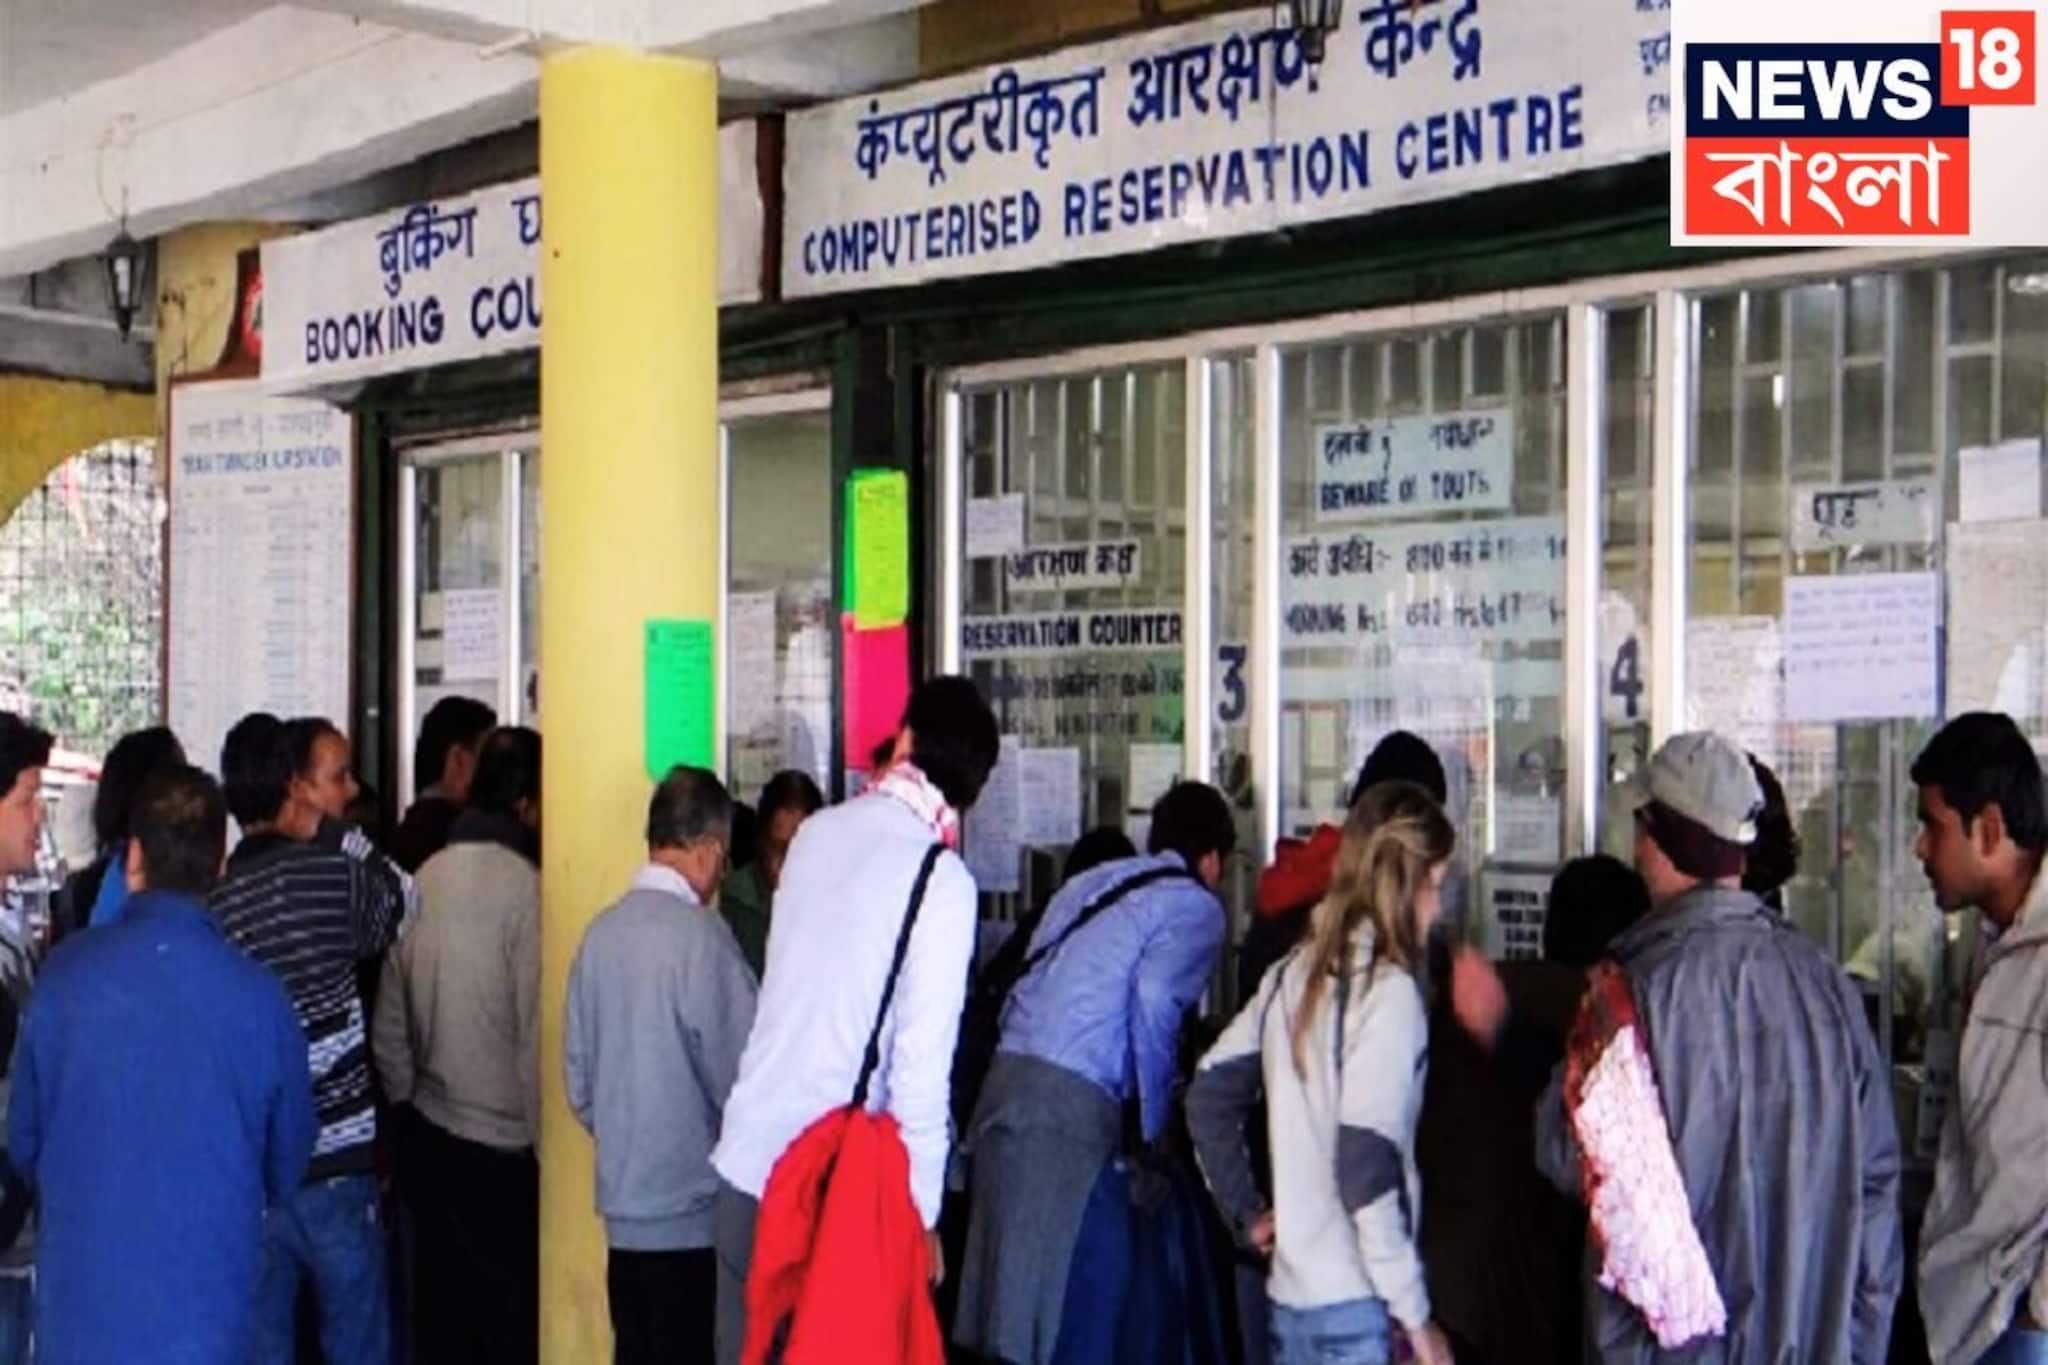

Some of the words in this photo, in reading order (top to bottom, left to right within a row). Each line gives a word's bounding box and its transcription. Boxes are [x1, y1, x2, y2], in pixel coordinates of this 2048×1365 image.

[804, 188, 1041, 275] COMPUTERISED
[1063, 130, 1370, 239] RESERVATION
[1395, 85, 1584, 180] CENTRE
[377, 202, 478, 296] बुकिंग
[306, 295, 444, 364] BOOKING
[471, 277, 541, 339] COU
[1321, 477, 1389, 510] BEWARE
[962, 615, 1081, 650] RESERVATION
[1089, 613, 1183, 647] COUNTER
[1217, 644, 1247, 722] 3
[1609, 634, 1644, 718] 4
